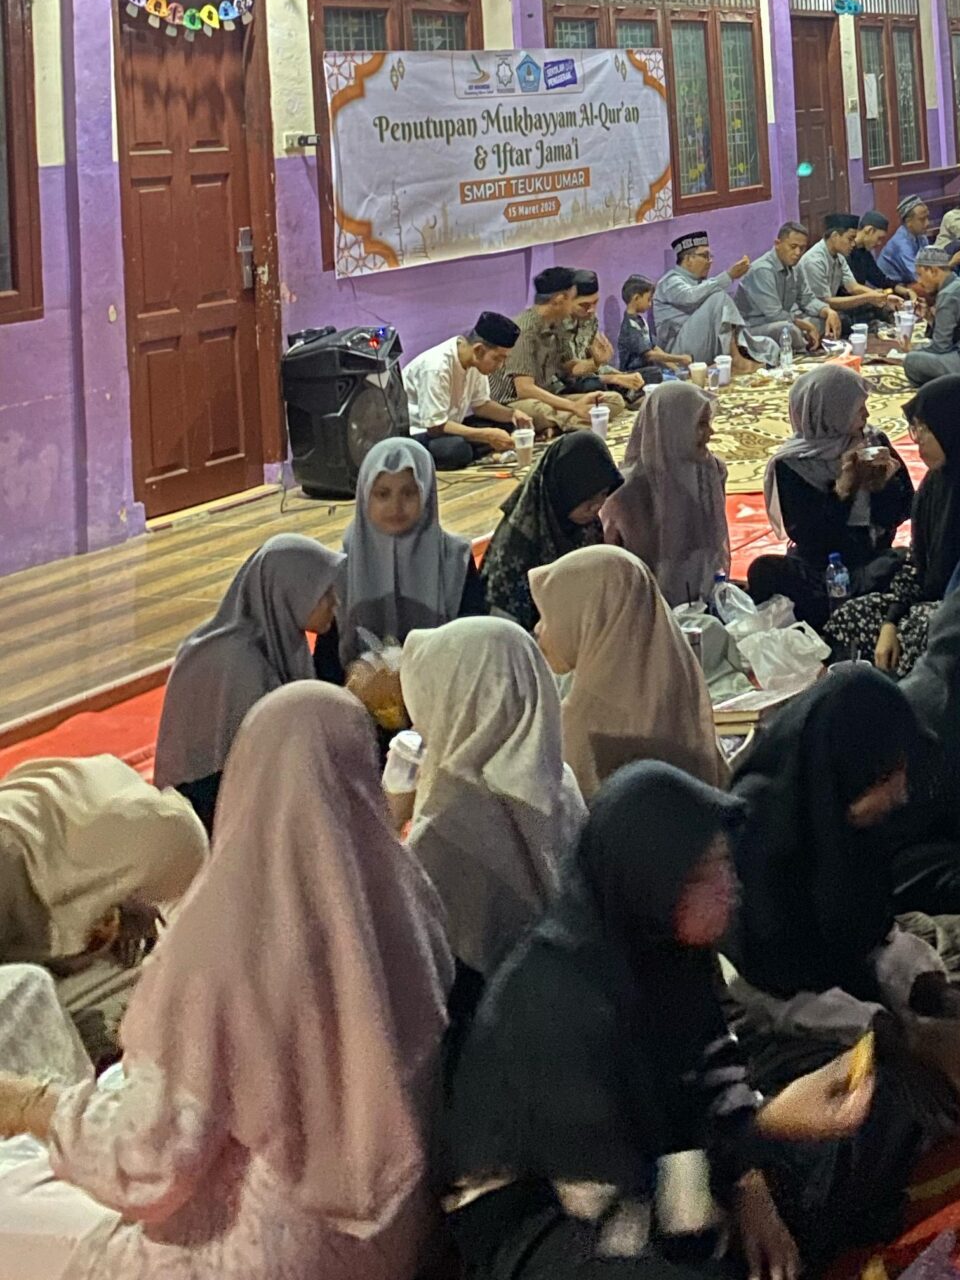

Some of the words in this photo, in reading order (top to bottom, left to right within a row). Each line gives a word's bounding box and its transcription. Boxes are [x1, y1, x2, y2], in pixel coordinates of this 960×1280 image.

[372, 115, 477, 146] Penutupan
[481, 103, 577, 138] Mukhayyam
[579, 101, 640, 131] Al-Qur'an
[474, 145, 488, 171] &
[491, 141, 532, 175] Iftar
[535, 137, 579, 170] Jama'i
[463, 180, 507, 201] SMPIT
[510, 175, 552, 195] TEUKU
[555, 171, 585, 189] UMAR
[508, 207, 516, 217] 15
[518, 204, 540, 217] Maret
[541, 201, 556, 213] 2025
